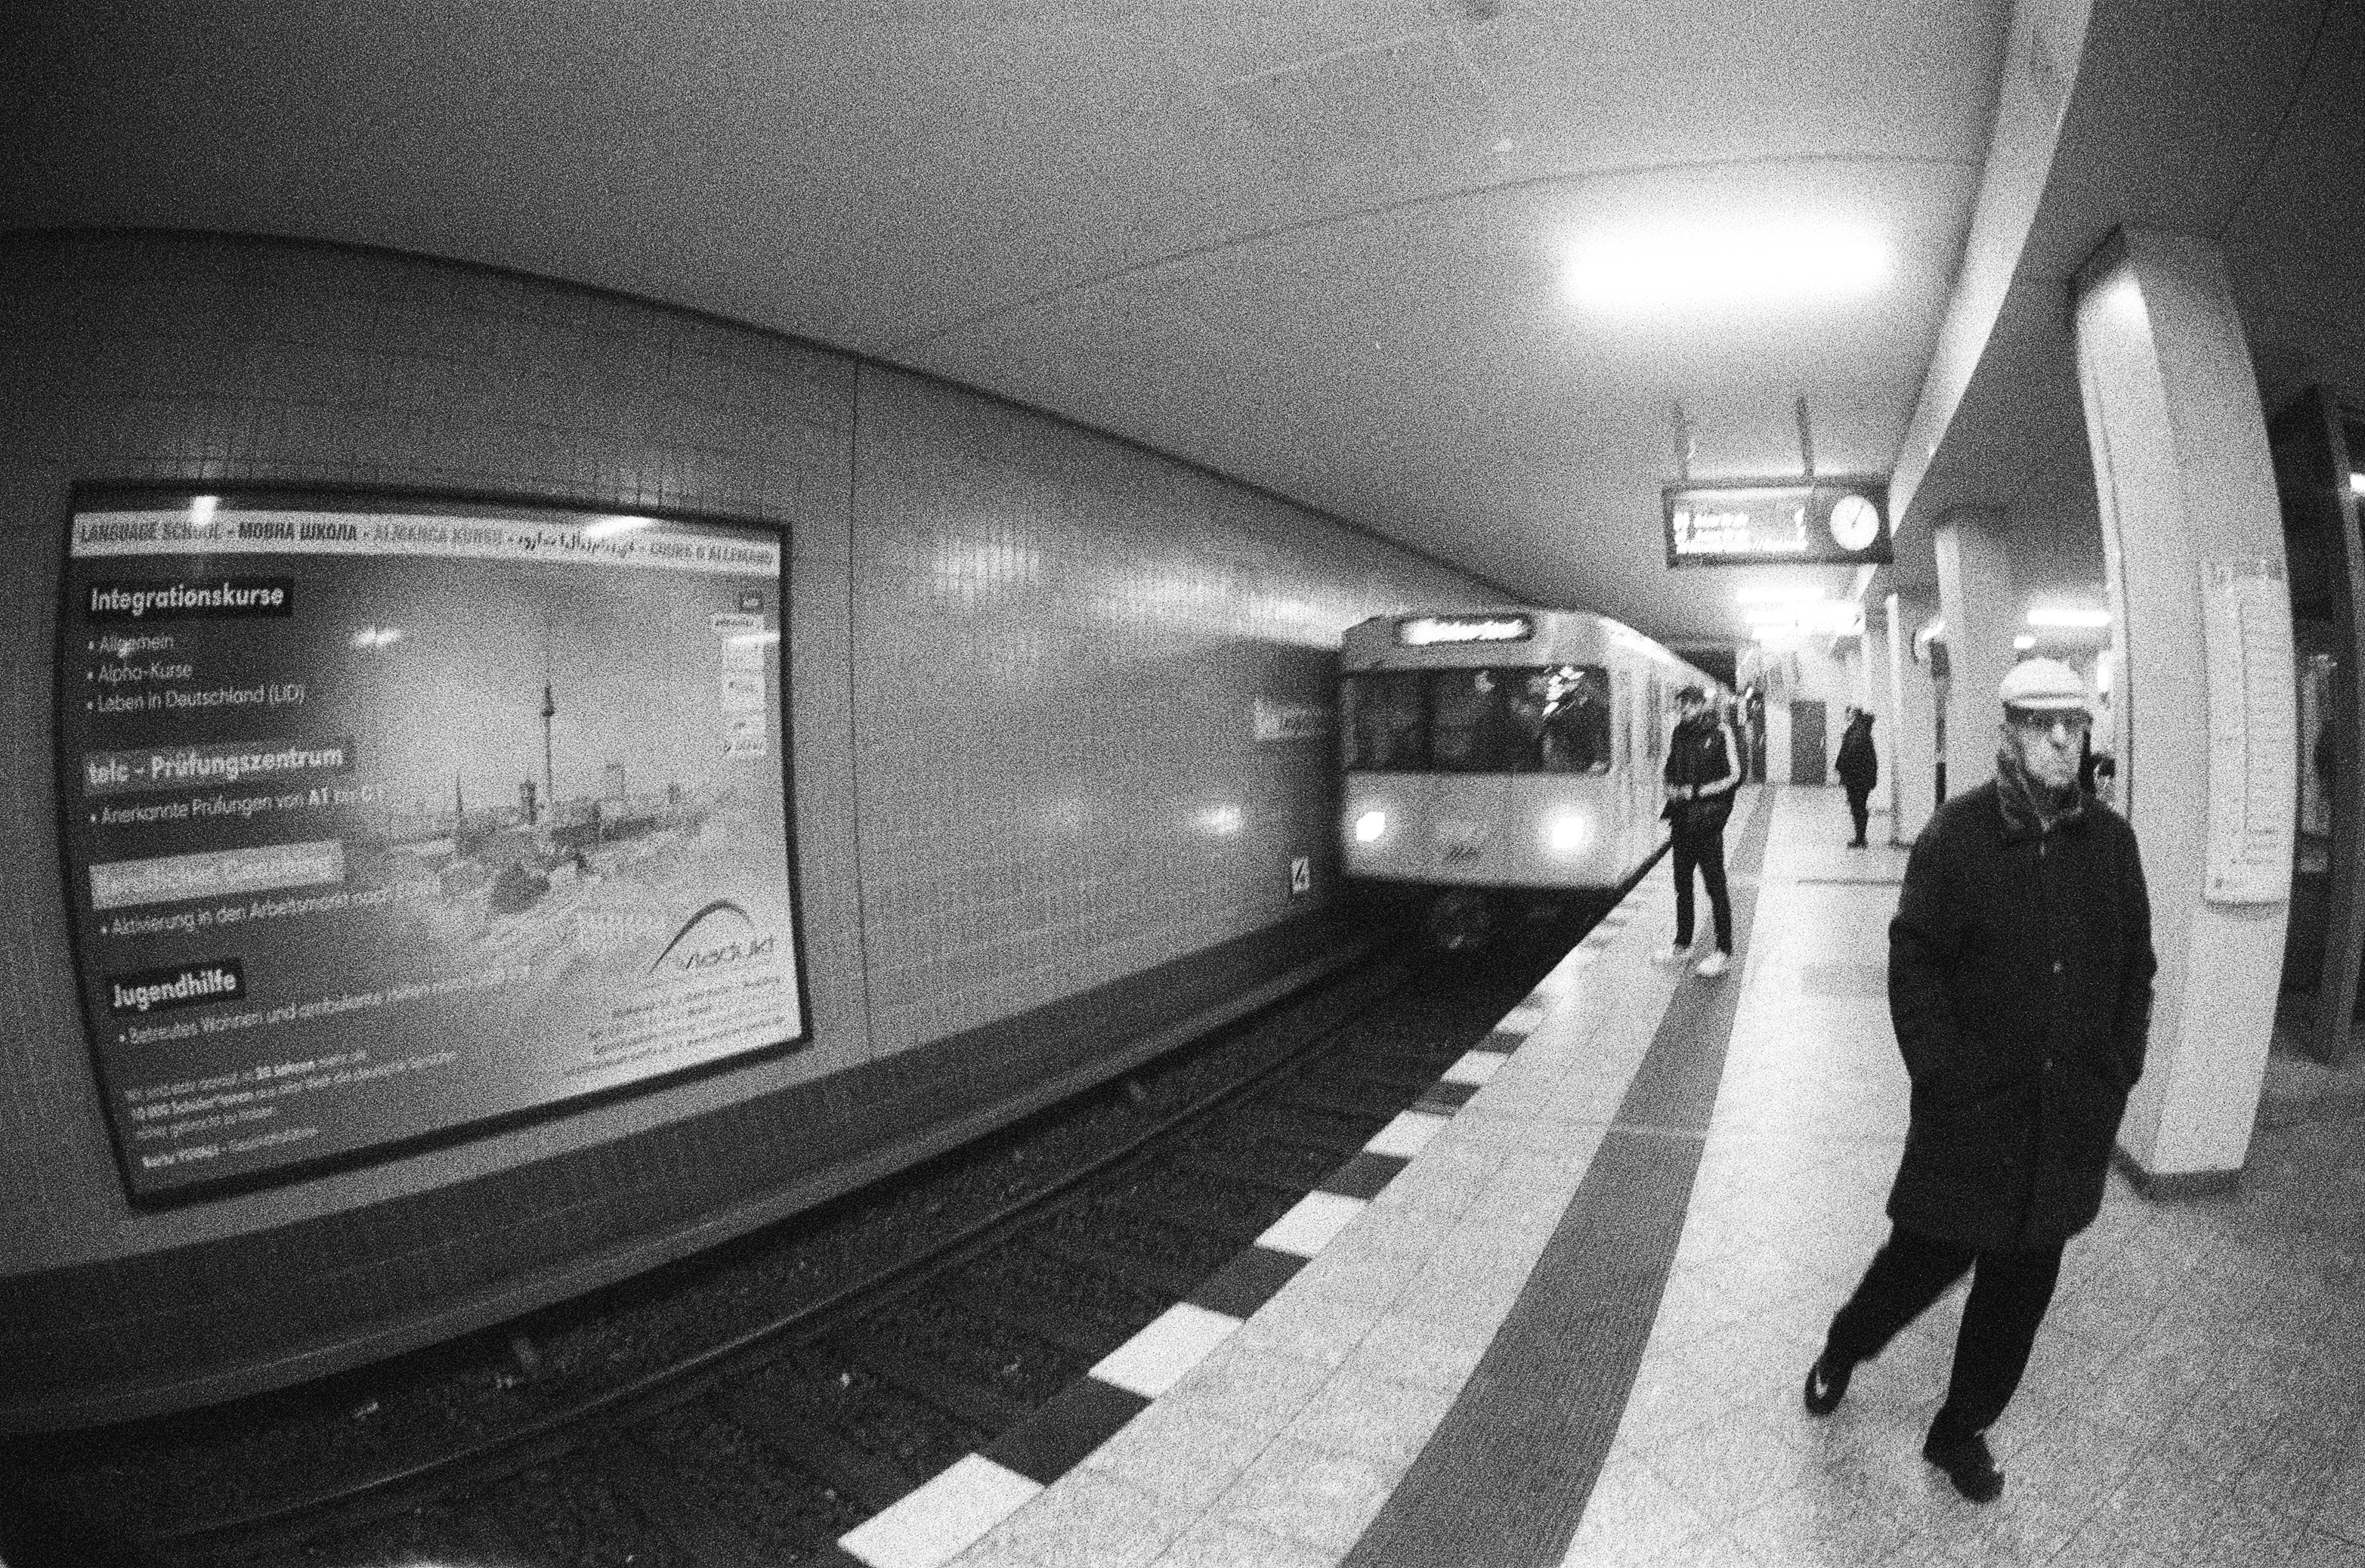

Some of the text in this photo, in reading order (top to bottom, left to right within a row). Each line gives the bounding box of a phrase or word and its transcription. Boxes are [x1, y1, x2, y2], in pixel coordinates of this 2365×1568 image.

[80, 521, 158, 543] LANGUAGE
[238, 521, 358, 541] МОВНА ШКОЛА
[91, 582, 286, 617] Integrationskurse
[99, 633, 175, 657] Allgemein
[98, 663, 193, 686] Alpha-Kurse
[98, 691, 145, 713] Leben
[147, 691, 162, 710] in
[165, 684, 264, 709] Deutschland
[151, 746, 344, 781] Prüfungszentrum
[101, 799, 189, 824] Anerkannte
[192, 794, 273, 818] Prüfungen
[277, 793, 303, 809] von
[111, 908, 196, 936] Aktivierung
[199, 905, 214, 925] in
[216, 901, 246, 924] den
[249, 892, 350, 920] Arbeitsmarkt
[113, 968, 236, 1012] Jugendhilfe
[201, 1011, 264, 1035] Wohnen
[266, 1002, 297, 1024] und
